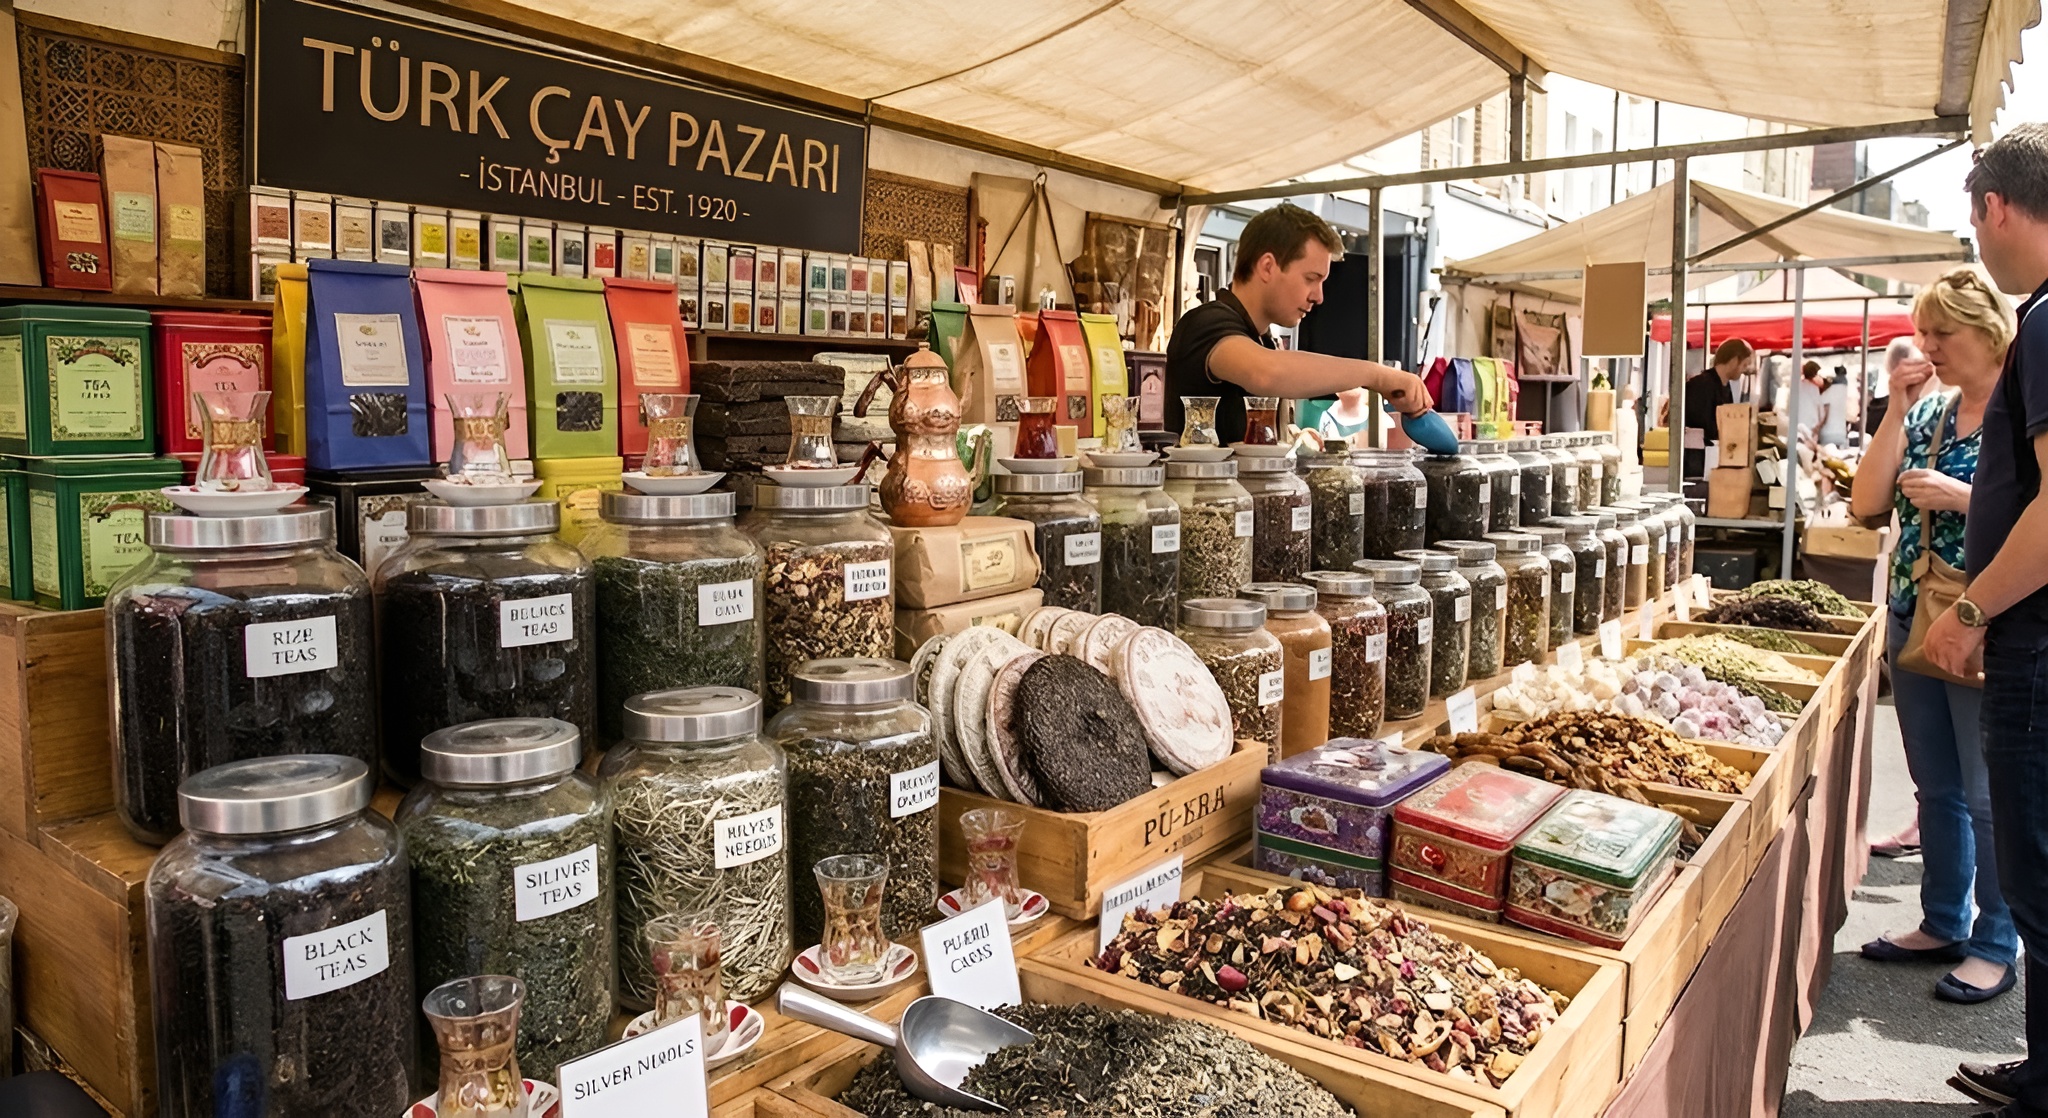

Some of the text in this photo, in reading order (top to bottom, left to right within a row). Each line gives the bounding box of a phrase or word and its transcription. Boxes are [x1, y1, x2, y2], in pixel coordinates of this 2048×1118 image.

[303, 36, 840, 194] TÜRK ÇAY PAZARI
[479, 156, 611, 206] İSTANBUL
[633, 184, 678, 215] EST.
[687, 193, 737, 222] 1920
[304, 927, 373, 961] BLACK
[315, 954, 368, 981] TEAS
[574, 1065, 633, 1100] SILVER
